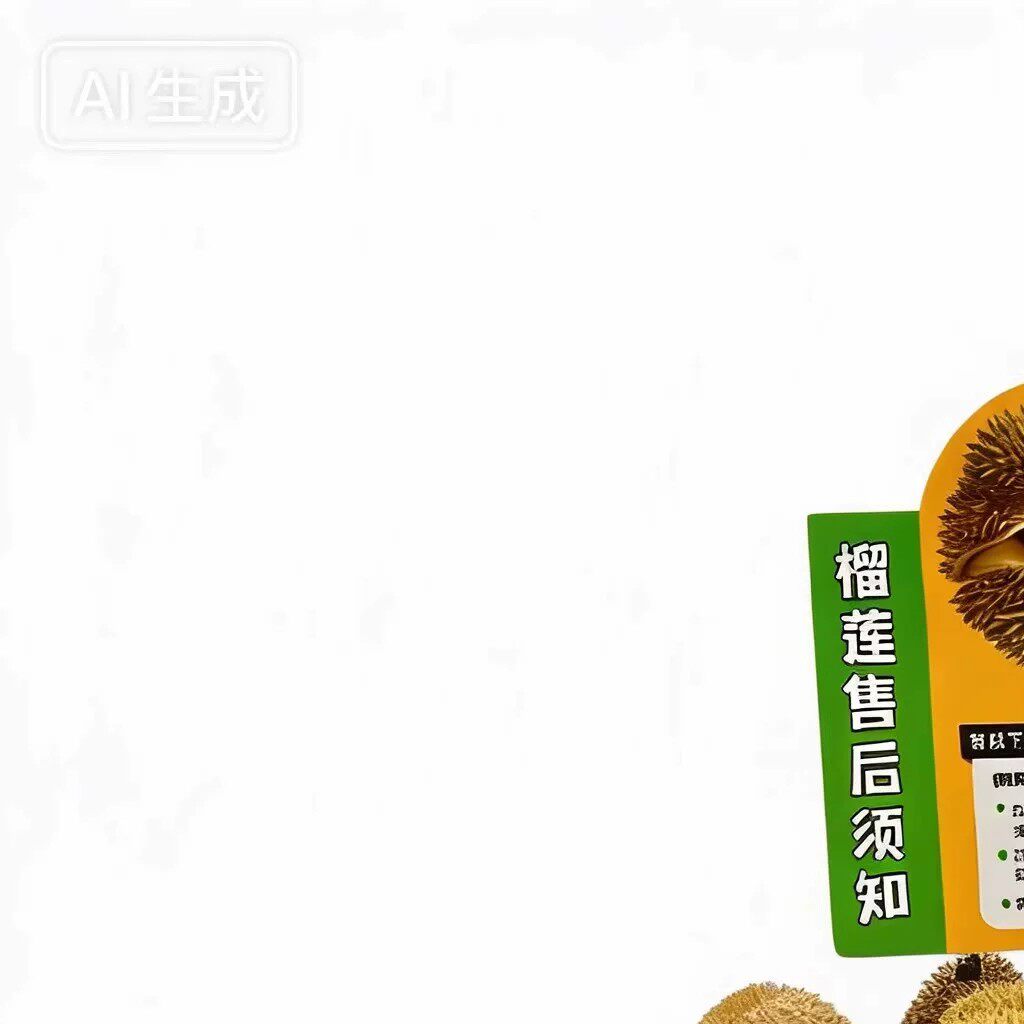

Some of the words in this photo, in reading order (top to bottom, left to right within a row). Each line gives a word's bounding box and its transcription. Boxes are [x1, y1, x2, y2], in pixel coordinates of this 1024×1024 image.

[835, 541, 911, 926] 榴莲售后须知
